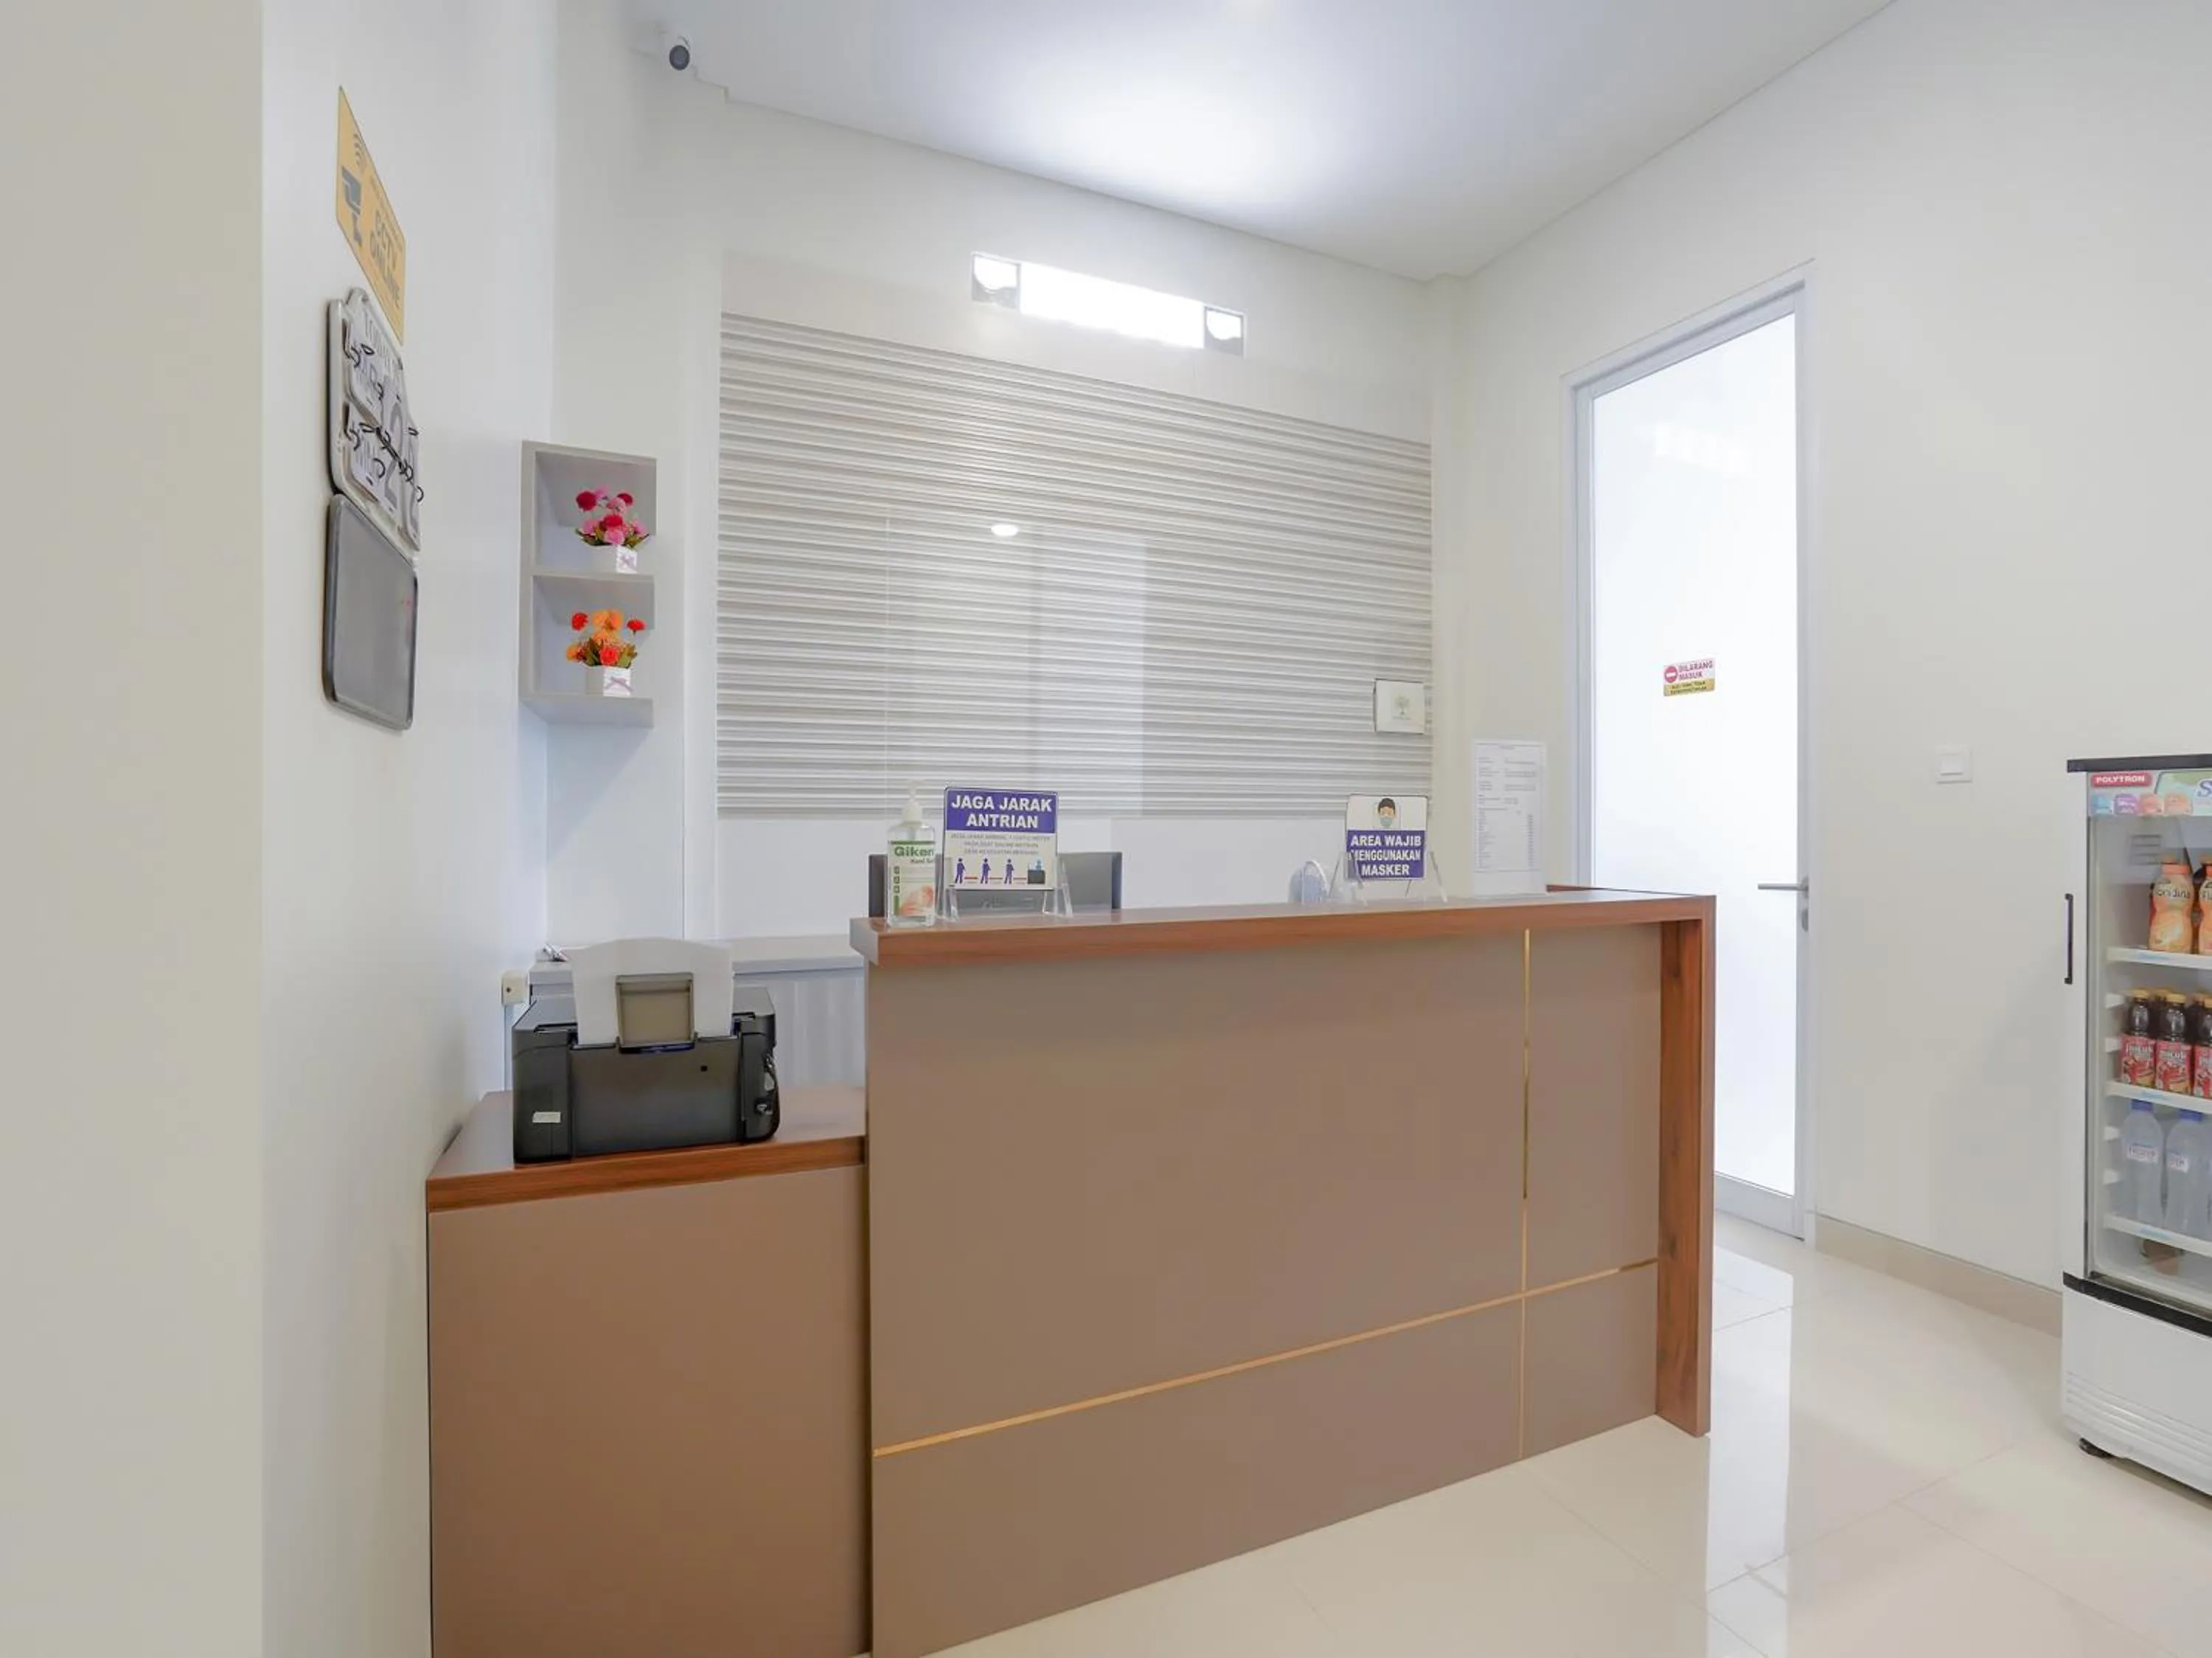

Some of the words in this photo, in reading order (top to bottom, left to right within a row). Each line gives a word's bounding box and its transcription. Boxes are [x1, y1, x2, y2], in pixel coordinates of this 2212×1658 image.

[1679, 661, 1714, 673] DILARANG
[2095, 775, 2146, 784] POLYTRON
[951, 794, 995, 810] JAGA
[999, 797, 1053, 812] JARAK
[966, 814, 1039, 828] ANTRIAN
[1351, 835, 1382, 846] AREA
[1384, 836, 1422, 847] WAJIB
[1362, 864, 1410, 876] MASKER
